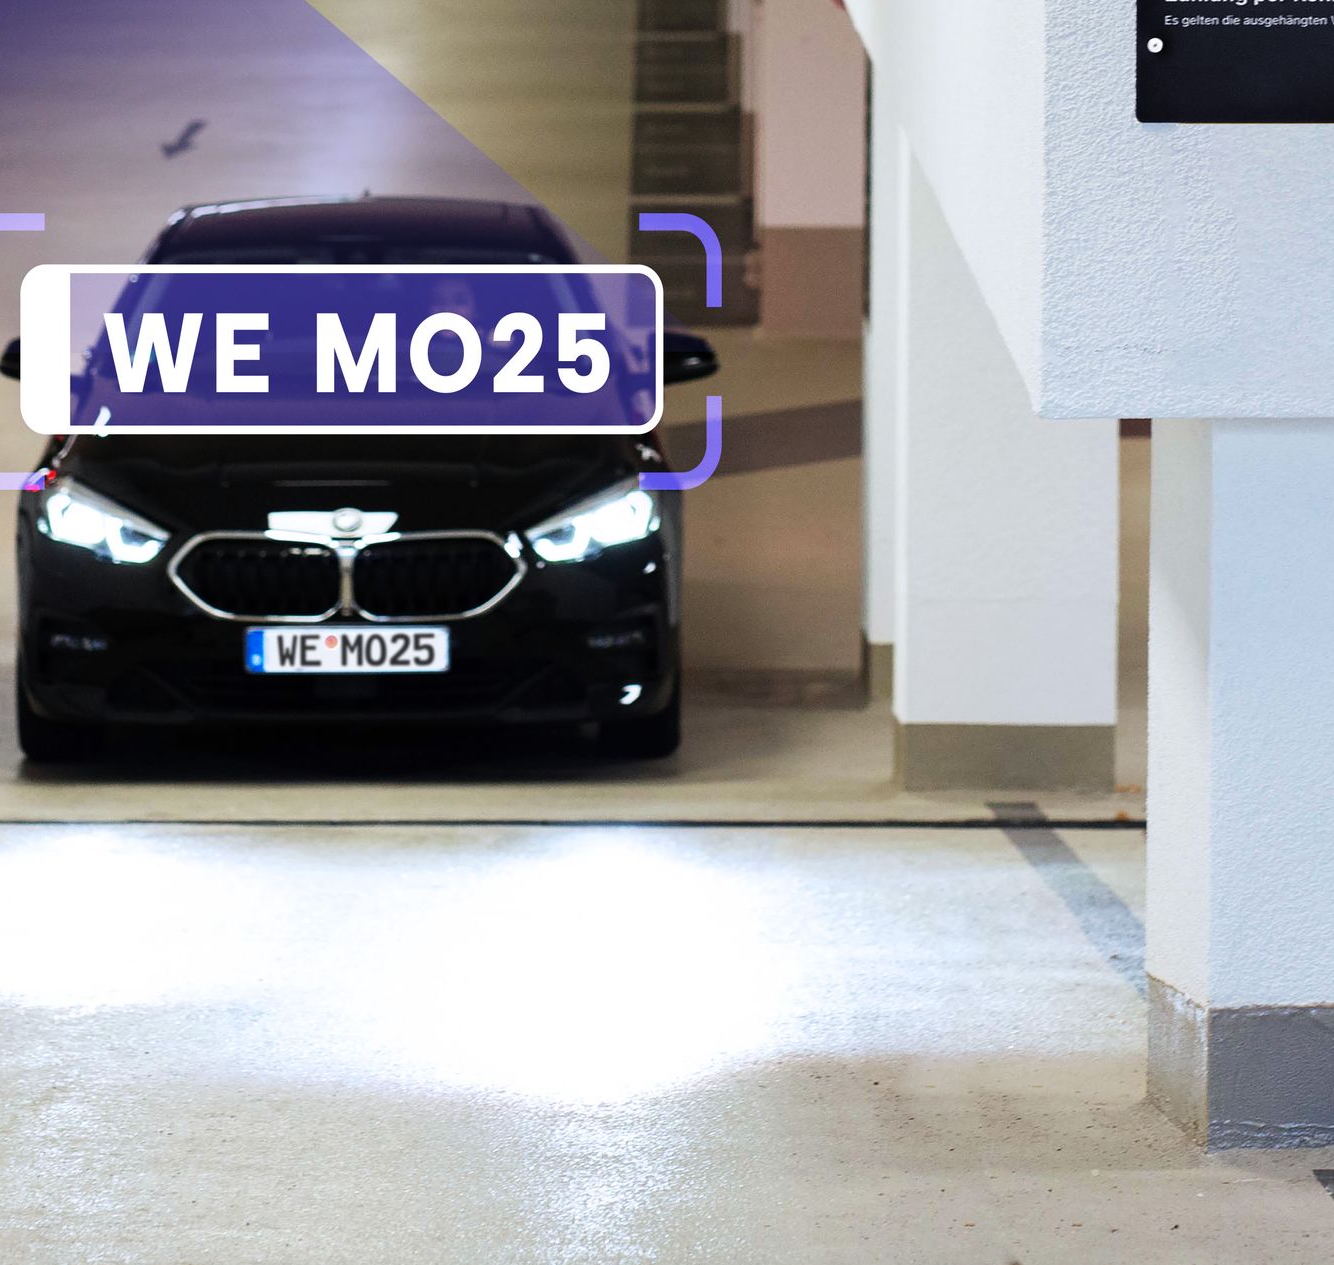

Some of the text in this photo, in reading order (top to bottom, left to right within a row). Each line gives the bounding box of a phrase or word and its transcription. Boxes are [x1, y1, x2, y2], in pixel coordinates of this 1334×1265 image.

[1164, 15, 1179, 26] Es
[1181, 15, 1219, 28] gelten
[1221, 15, 1240, 26] die
[1242, 15, 1328, 28] ausgehängten
[276, 633, 436, 667] WE MO25
